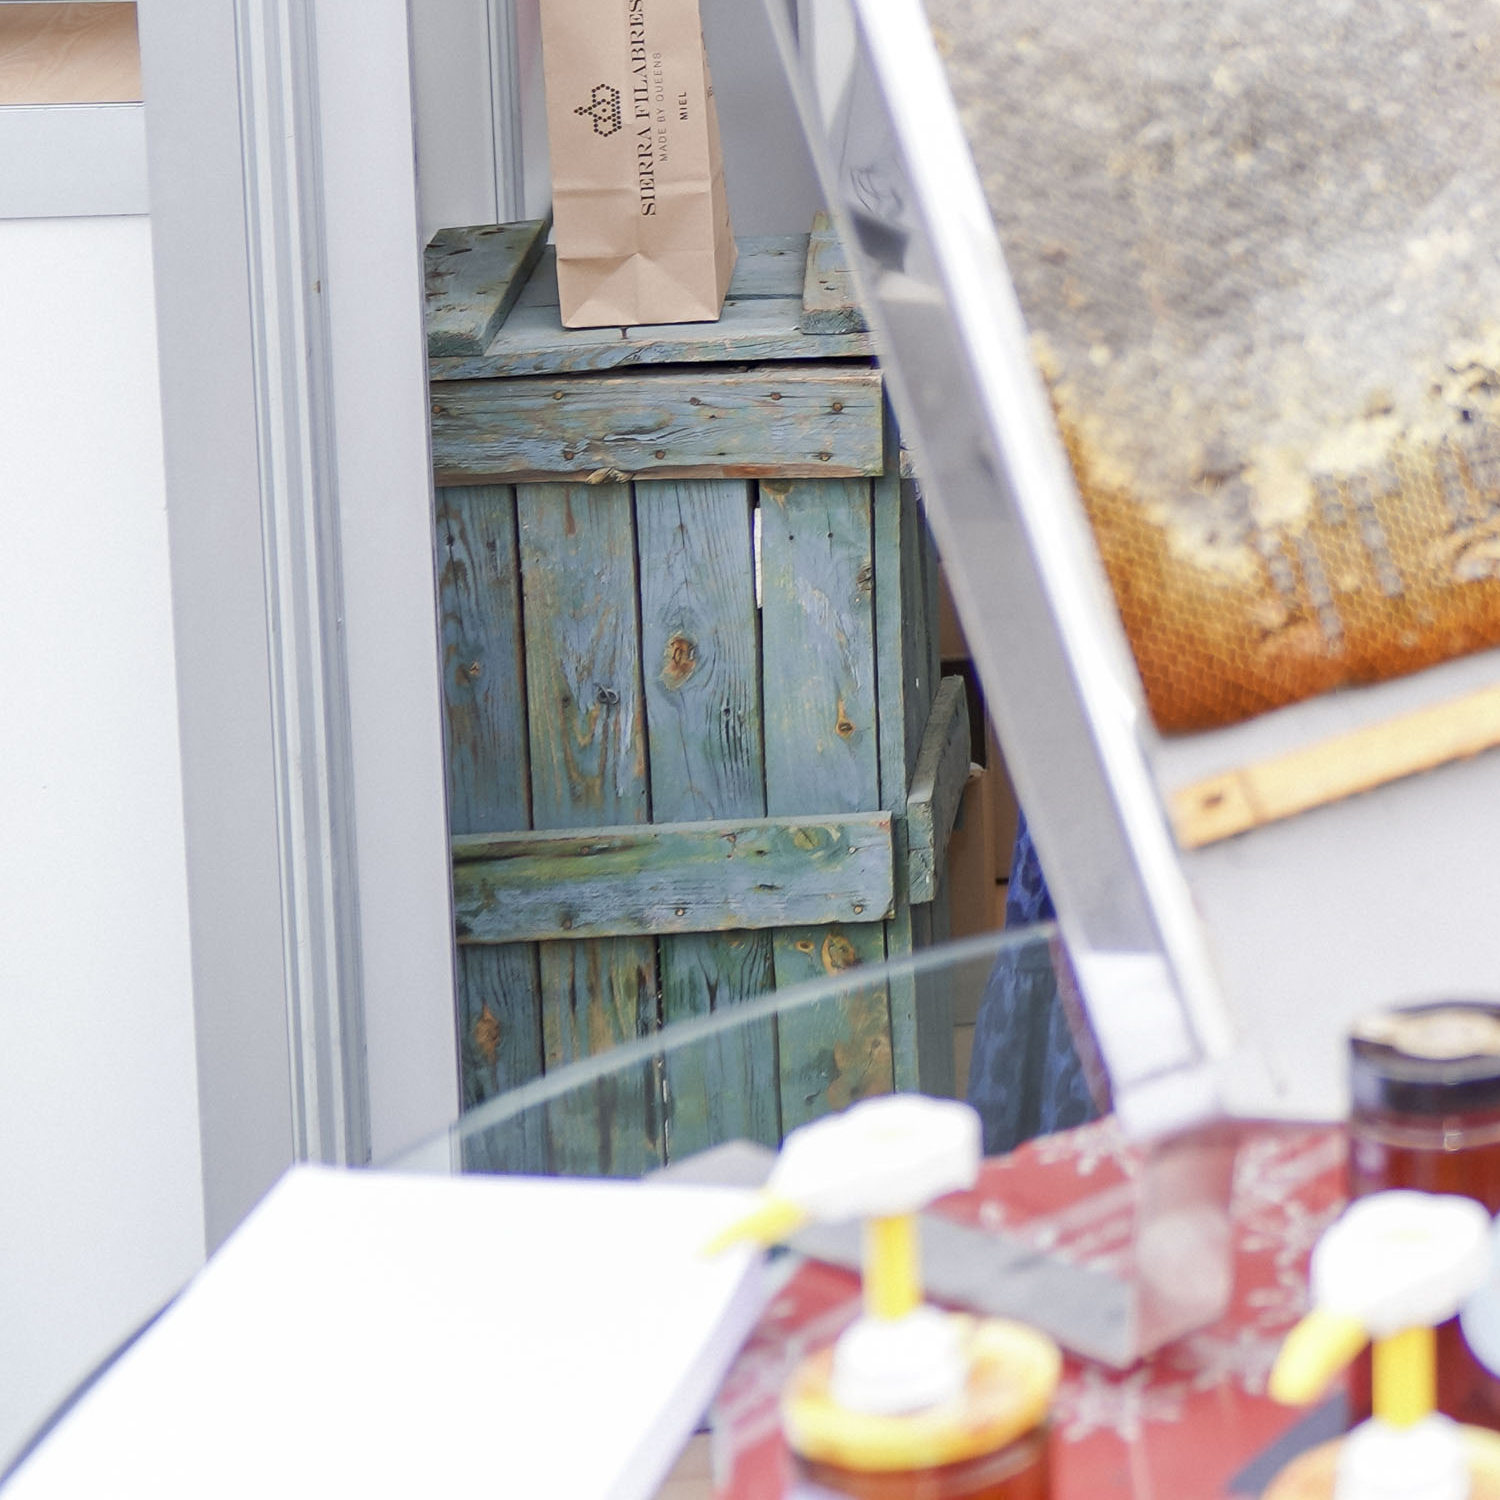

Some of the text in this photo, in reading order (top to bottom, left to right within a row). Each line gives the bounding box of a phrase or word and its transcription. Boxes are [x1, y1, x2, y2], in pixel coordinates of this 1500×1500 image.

[652, 53, 669, 162] MADE BY QUEENS
[679, 91, 689, 121] MIEL
[636, 126, 657, 216] SIERRA
